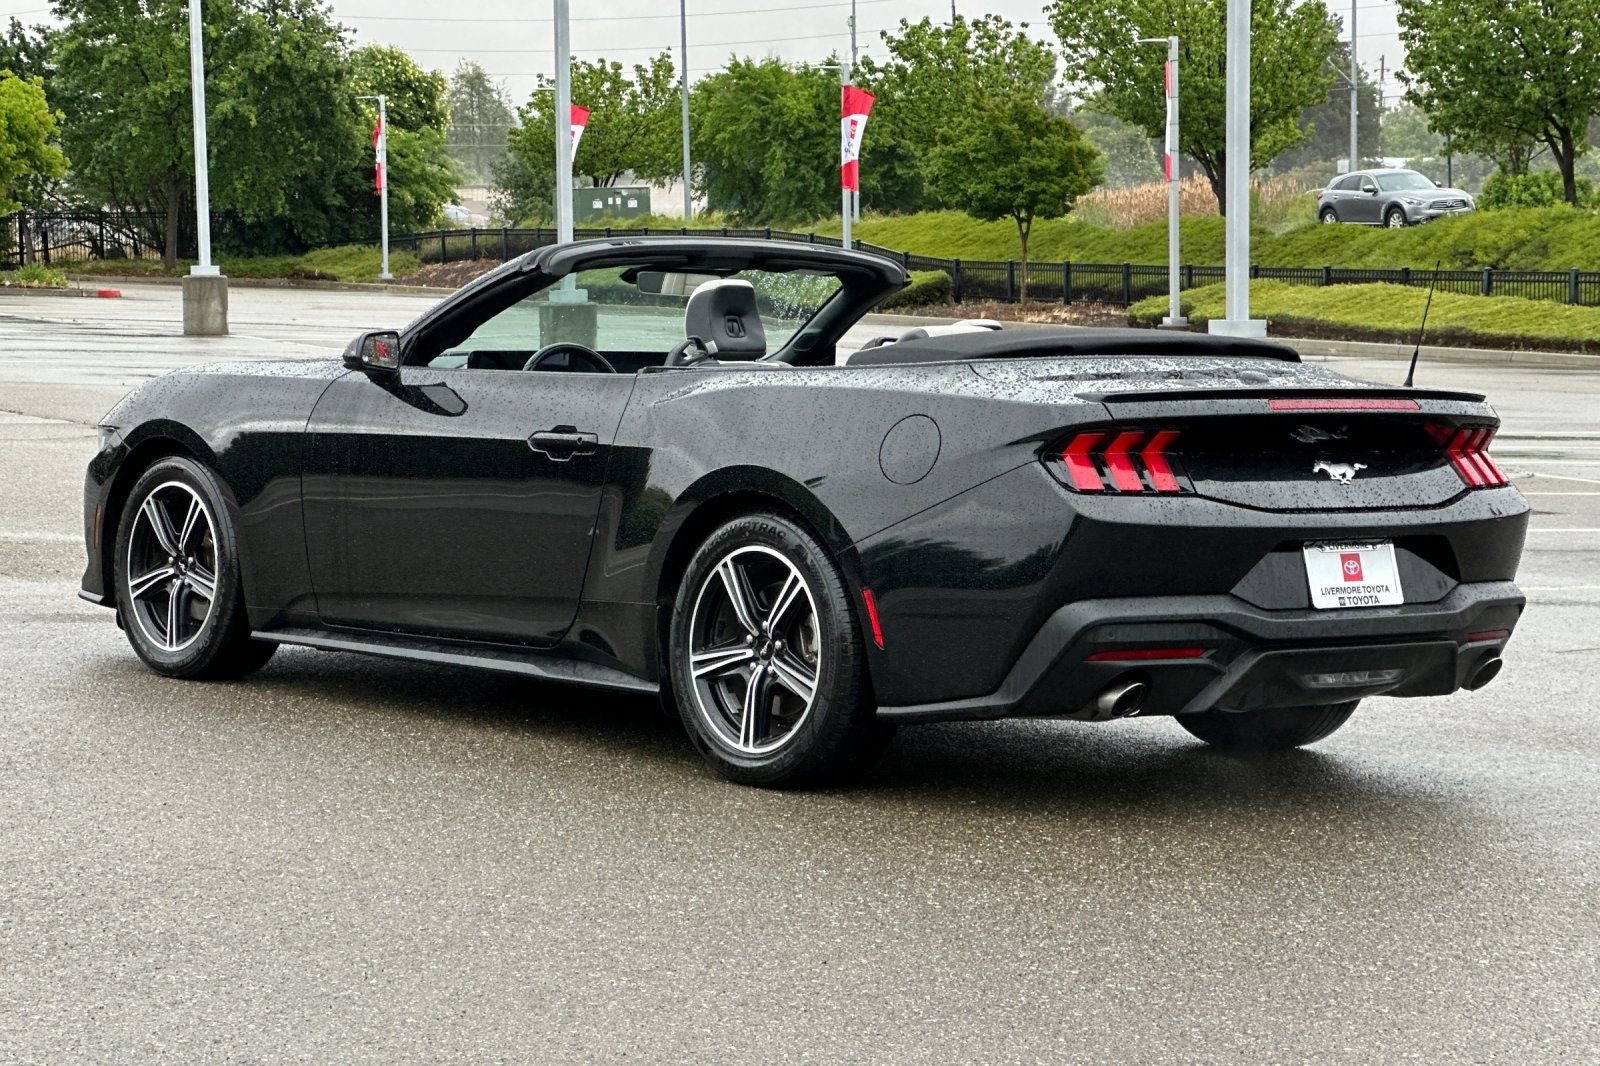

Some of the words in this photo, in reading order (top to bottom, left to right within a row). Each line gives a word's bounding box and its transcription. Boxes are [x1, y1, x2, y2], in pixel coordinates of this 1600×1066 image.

[1320, 585, 1362, 596] LIVERMORE
[1362, 584, 1390, 594] TOYOTA
[1347, 595, 1381, 605] TOYOTA
